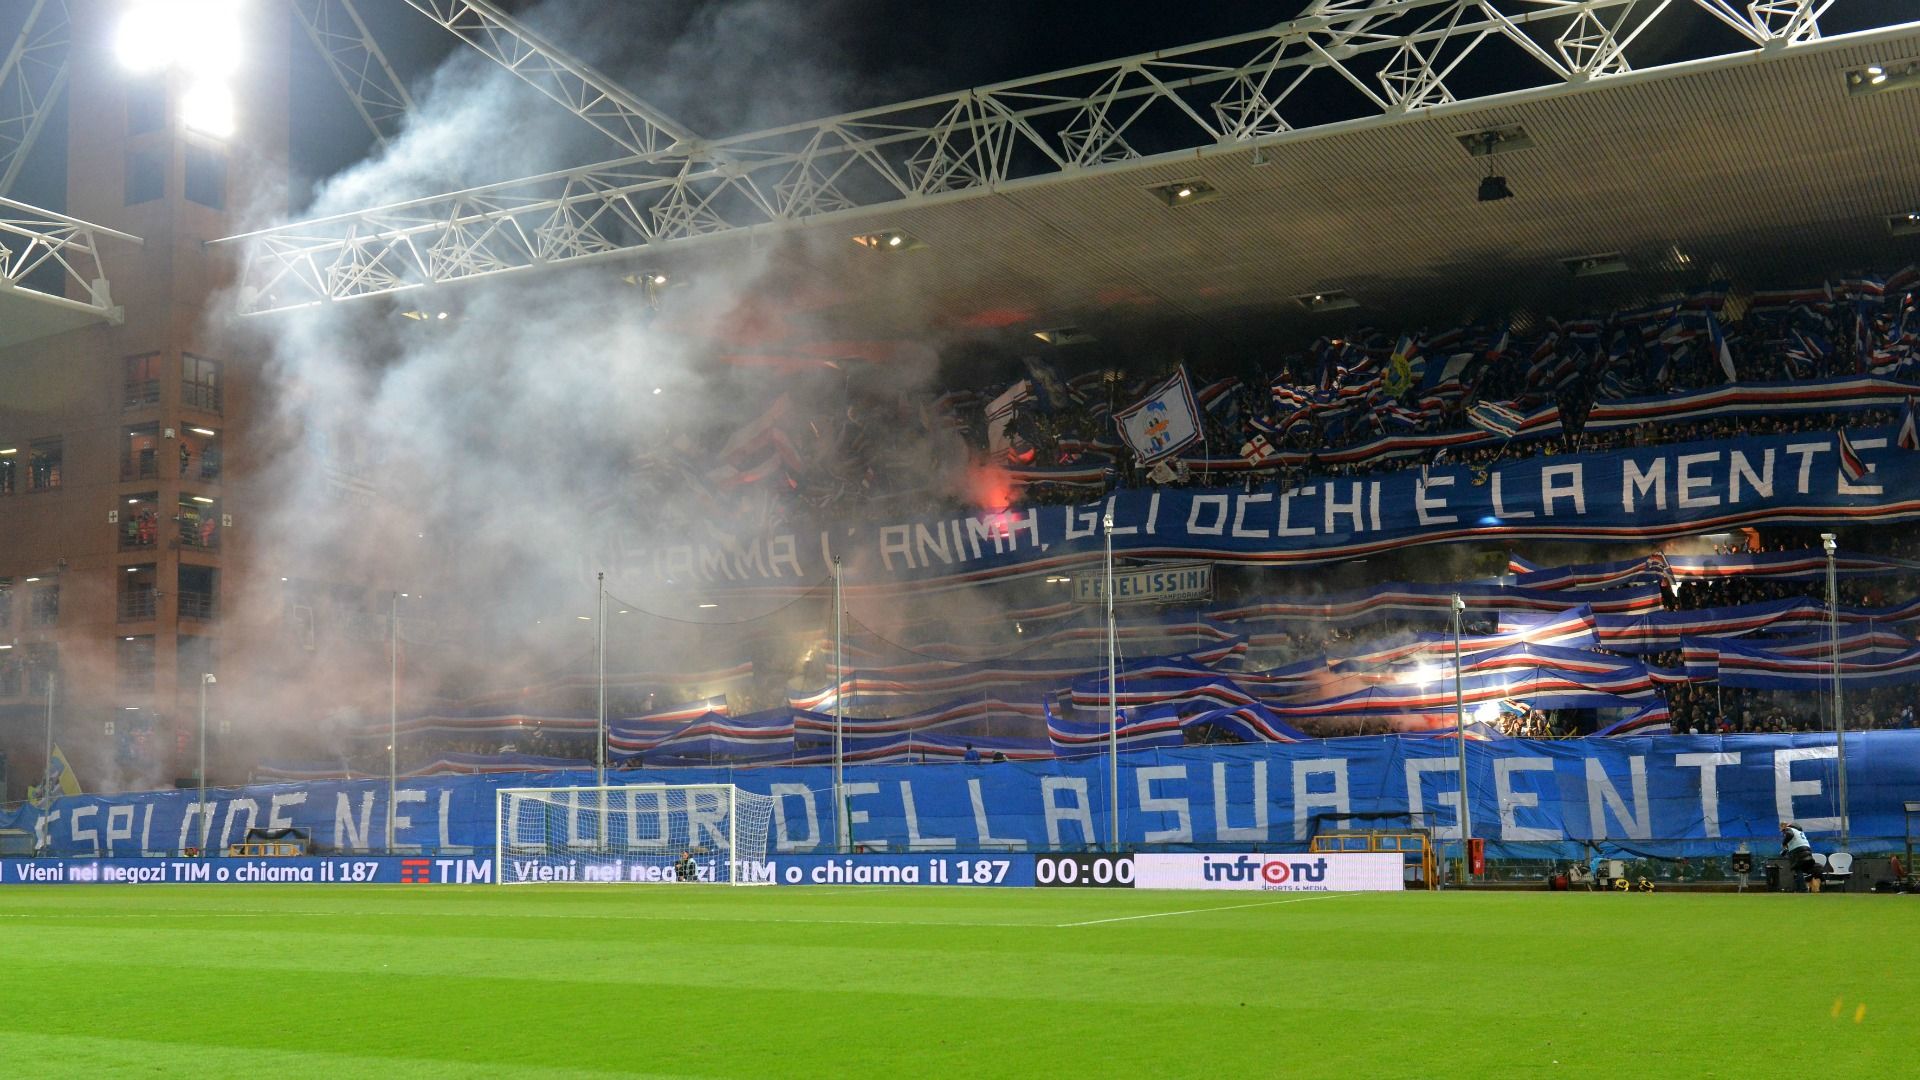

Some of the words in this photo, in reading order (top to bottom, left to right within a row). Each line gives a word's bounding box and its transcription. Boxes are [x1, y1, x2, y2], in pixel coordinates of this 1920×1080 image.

[1066, 492, 1160, 541] GLI
[1187, 481, 1381, 538] OCCHI
[1415, 476, 1458, 525] E
[1491, 463, 1587, 519] LA
[1621, 438, 1887, 513] MENTE
[34, 791, 308, 858] ESPLODE
[334, 788, 474, 855] NEL
[508, 783, 734, 852] CUOR
[770, 776, 1096, 852] DELLA
[1136, 758, 1350, 843] SUA
[1404, 746, 1850, 841] GENTE
[16, 862, 64, 881] Vieni
[69, 862, 98, 882] nei
[104, 862, 166, 884] negozi
[172, 863, 210, 882] TIM
[216, 866, 230, 882] o
[235, 862, 314, 882] chiama
[320, 861, 334, 882] il
[339, 862, 379, 882] 187
[435, 859, 492, 884] TIM
[513, 860, 576, 881] Vieni
[585, 860, 623, 882] nei
[631, 860, 716, 883] negzi
[785, 866, 803, 884] o
[811, 859, 920, 883] chiama
[930, 859, 949, 883] il
[956, 860, 1010, 883] 187
[1036, 858, 1135, 884] 00:00
[1203, 855, 1328, 884] infront
